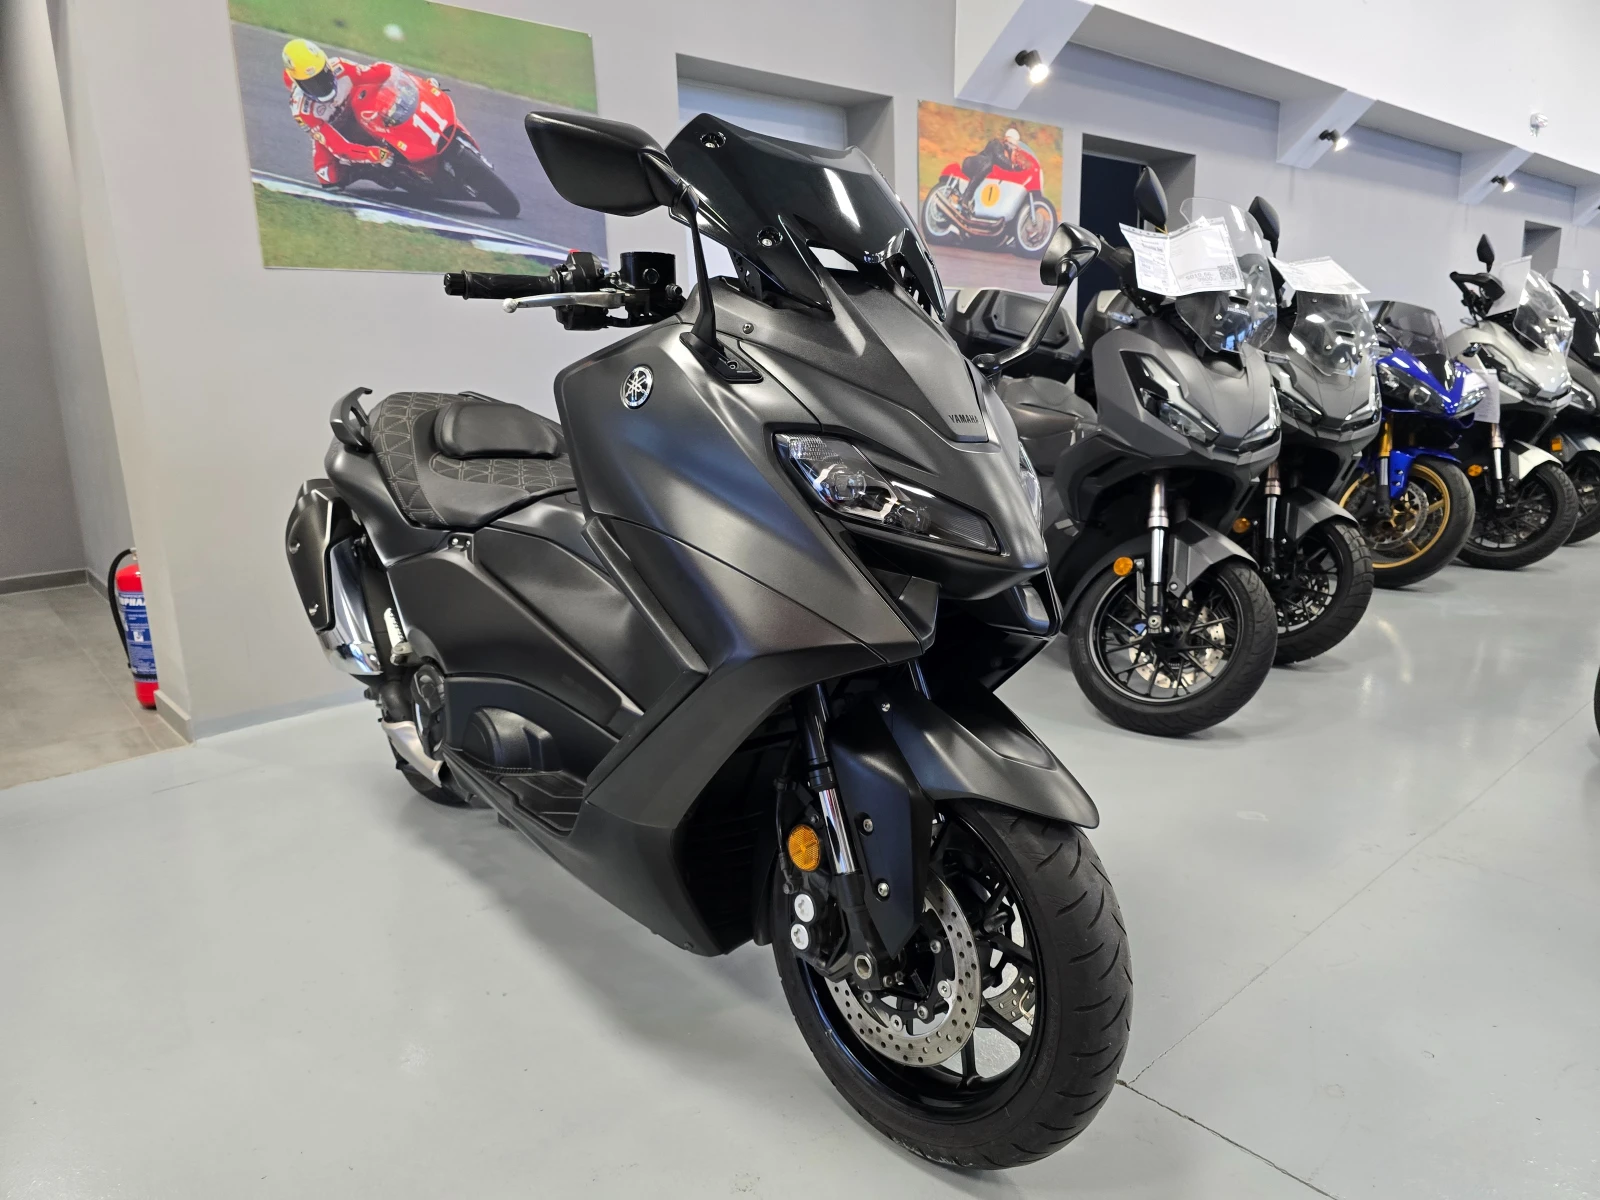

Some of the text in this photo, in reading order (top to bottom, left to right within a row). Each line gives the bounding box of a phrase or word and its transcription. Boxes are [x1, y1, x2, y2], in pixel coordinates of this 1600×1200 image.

[412, 101, 448, 146] 11
[1227, 306, 1250, 316] HONDA
[948, 414, 979, 424] YAMAHA
